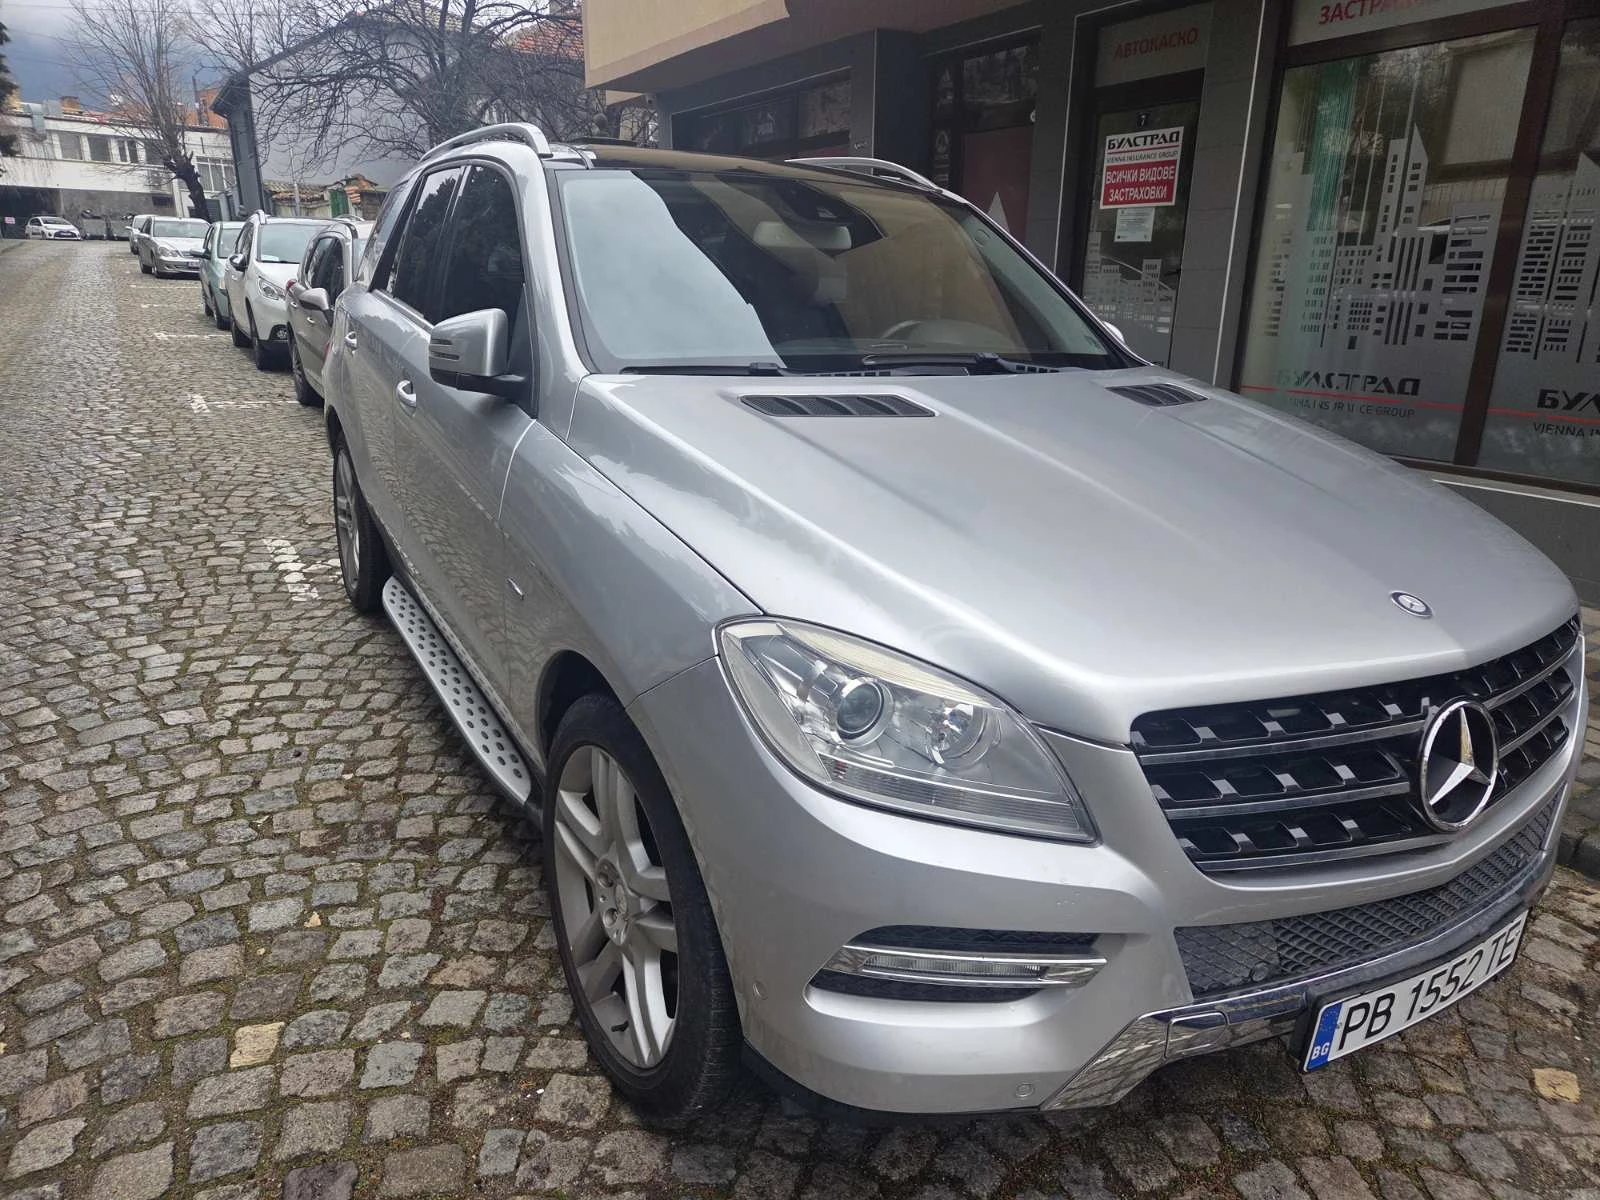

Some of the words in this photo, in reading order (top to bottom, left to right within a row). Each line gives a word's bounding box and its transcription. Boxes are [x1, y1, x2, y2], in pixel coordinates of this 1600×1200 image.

[1114, 27, 1199, 59] АВТОКАСКО
[1107, 130, 1181, 150] БУЛСТРАД
[1106, 169, 1138, 184] ВСИЧКИ
[1139, 166, 1175, 182] ВИДОВЕ
[1109, 185, 1167, 202] ЗАСТРАХОВКИ
[1375, 406, 1415, 418] GROUP
[1533, 421, 1585, 438] VIENNA
[1339, 992, 1396, 1051] PB
[1407, 949, 1484, 1021] 1552
[1485, 919, 1522, 976] TE
[1312, 1042, 1329, 1060] BG
